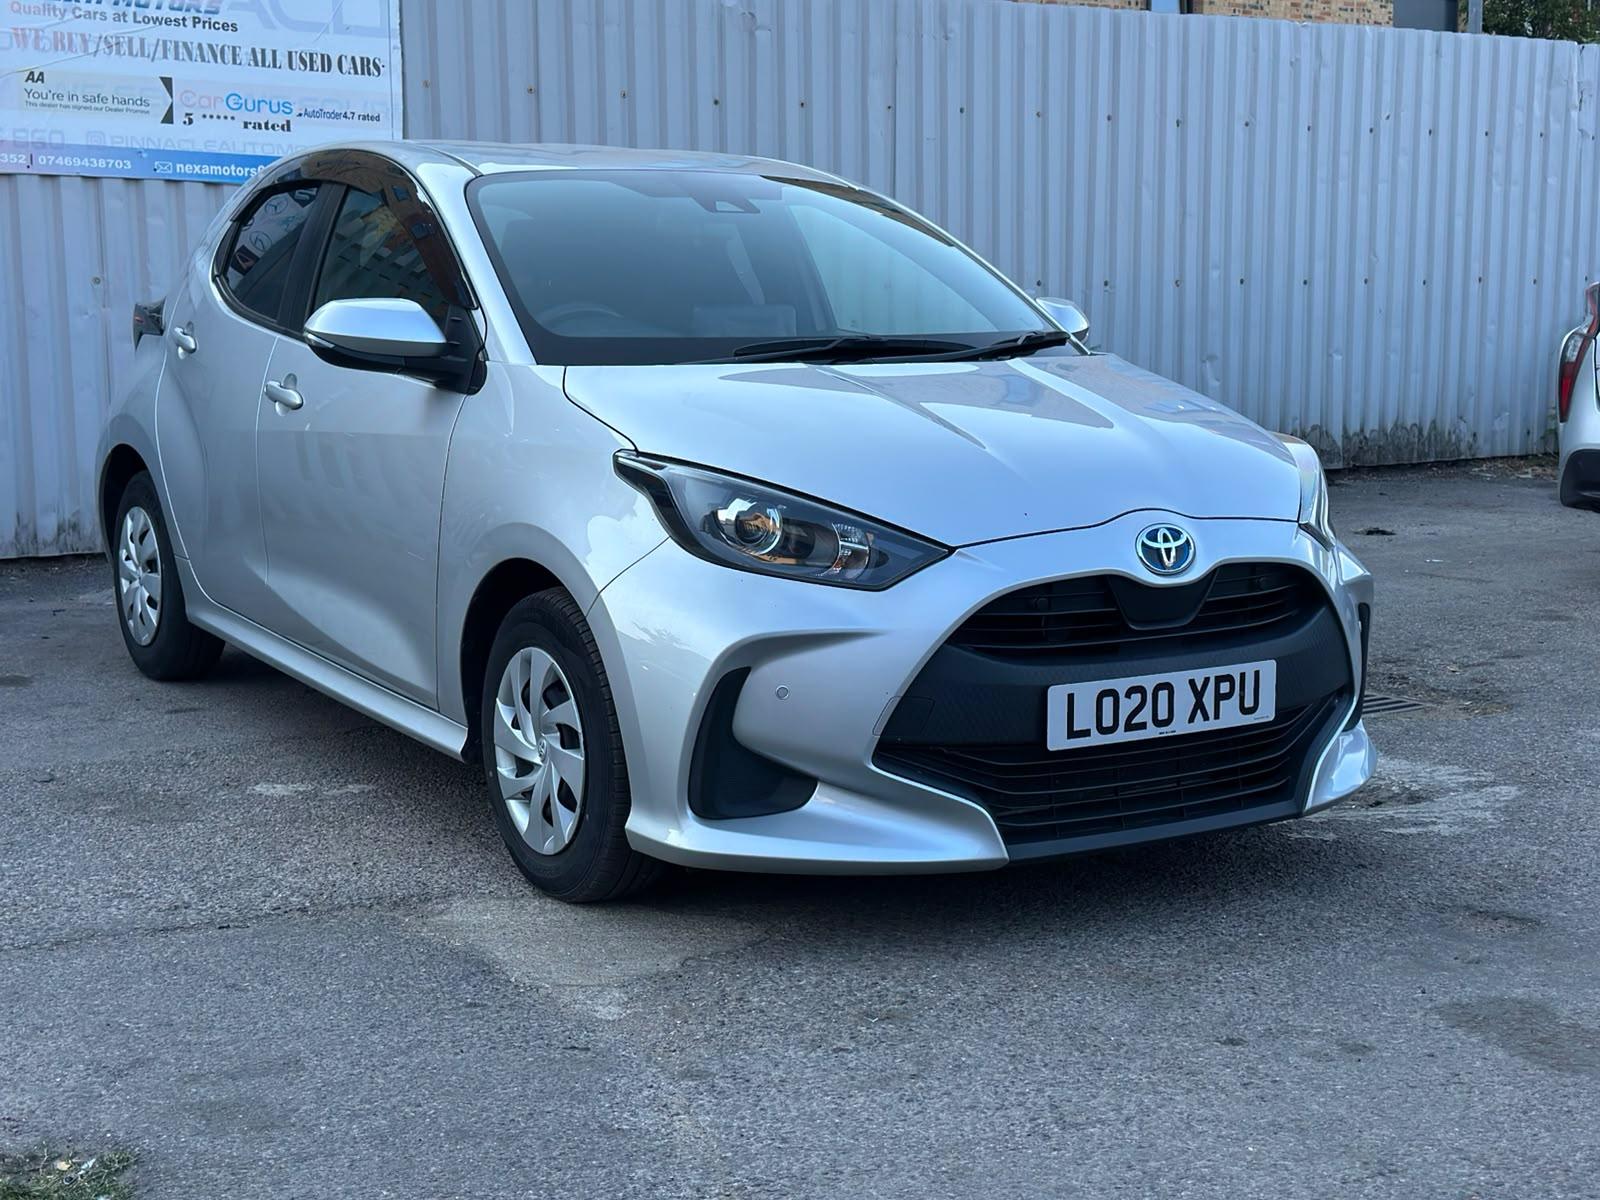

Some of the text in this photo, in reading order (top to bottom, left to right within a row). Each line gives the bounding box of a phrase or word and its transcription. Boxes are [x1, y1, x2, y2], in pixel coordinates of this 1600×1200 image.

[10, 1, 67, 20] Quality
[71, 6, 108, 22] Cars
[112, 10, 129, 23] at
[132, 10, 188, 28] Lowest
[192, 15, 239, 33] Prices
[11, 27, 45, 51] WE
[248, 47, 282, 69] ALL
[287, 51, 332, 74] USED
[24, 71, 45, 84] AA
[24, 87, 151, 107] You're in safe hands
[179, 89, 294, 116] CarGurus
[182, 112, 195, 126] 5
[242, 118, 292, 133] rated
[357, 113, 381, 122] rated
[0, 152, 132, 169] 352 07469438703
[1066, 670, 1261, 740] LO20 XPU
